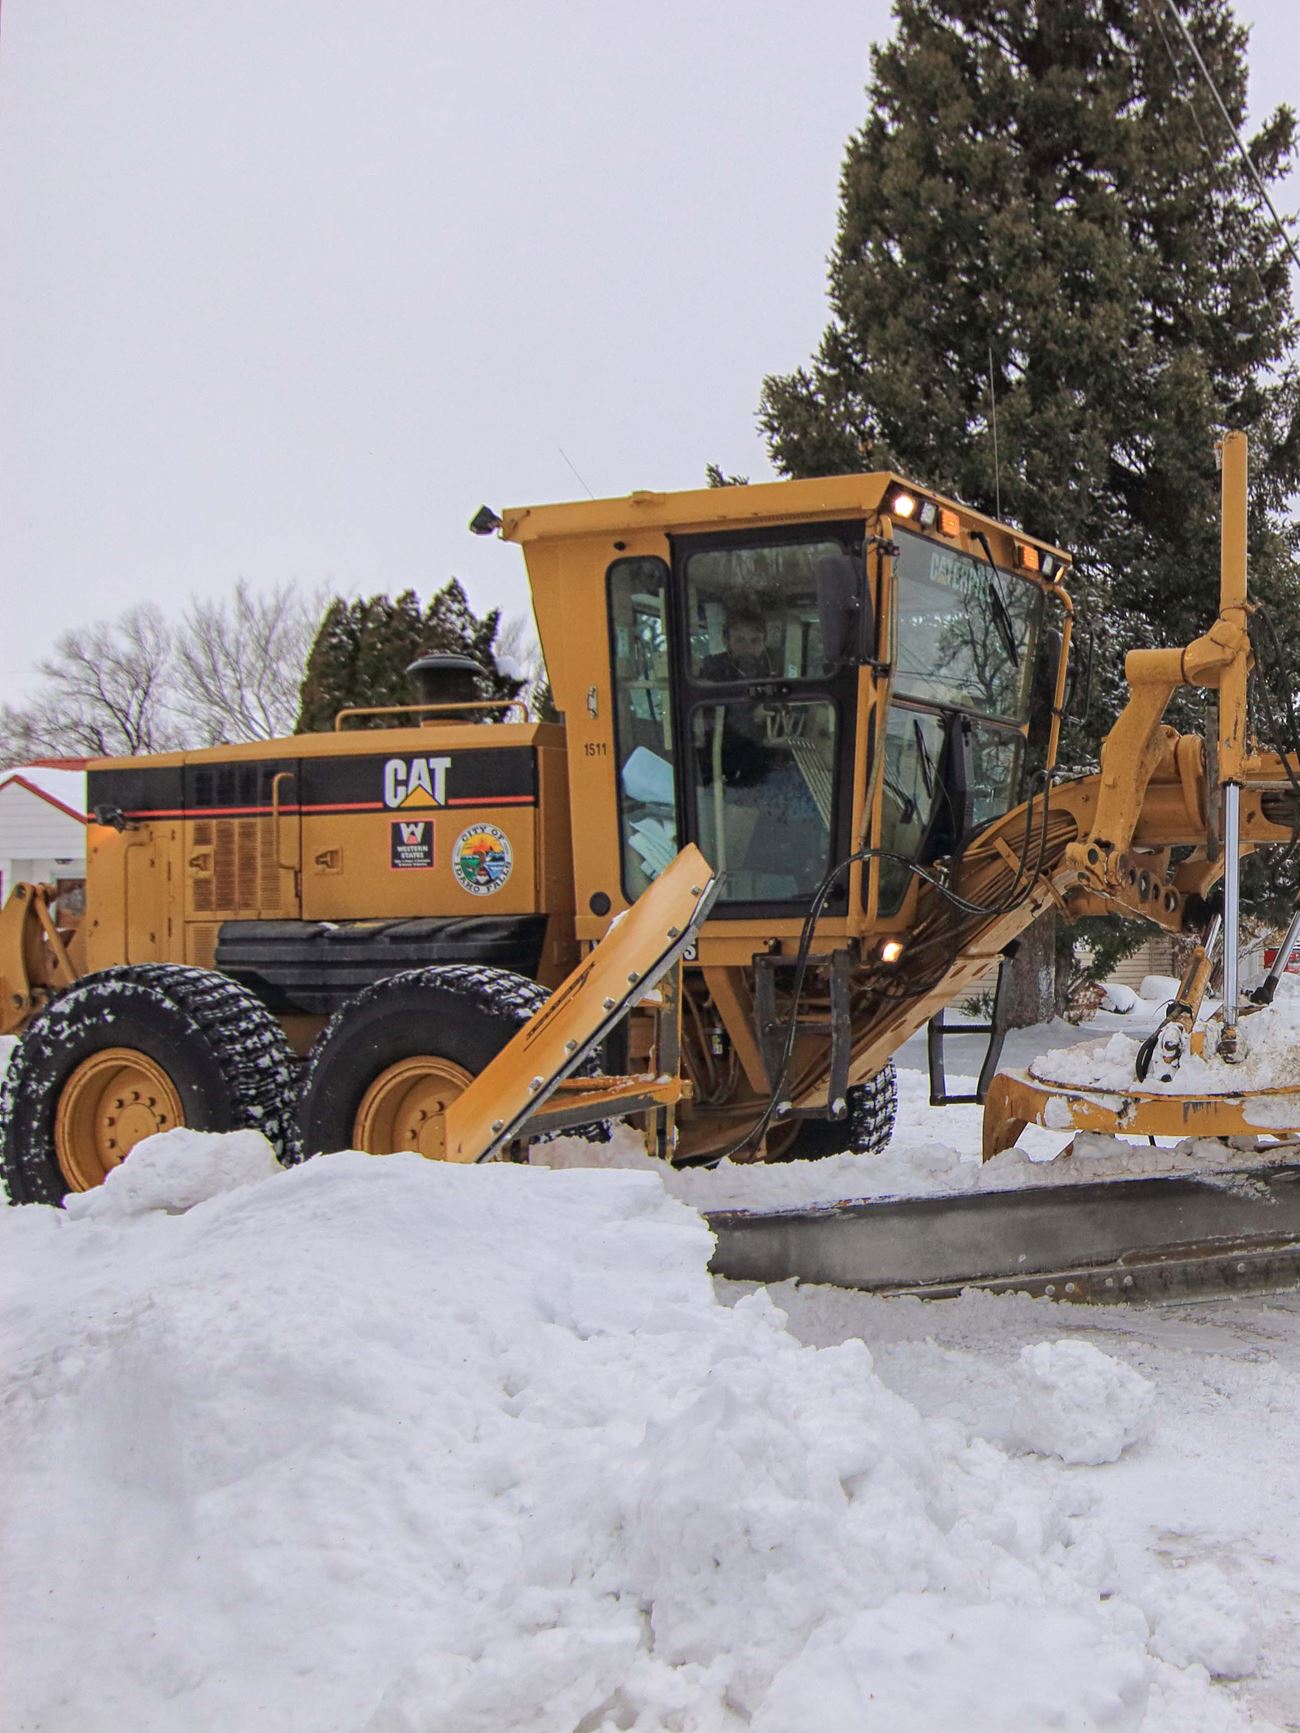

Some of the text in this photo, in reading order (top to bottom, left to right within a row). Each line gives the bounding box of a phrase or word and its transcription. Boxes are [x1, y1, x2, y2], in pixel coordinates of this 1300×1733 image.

[584, 743, 607, 756] 1511
[384, 757, 452, 808] CAT
[462, 826, 505, 842] CITY OF
[454, 861, 511, 893] IDAHO FALLS
